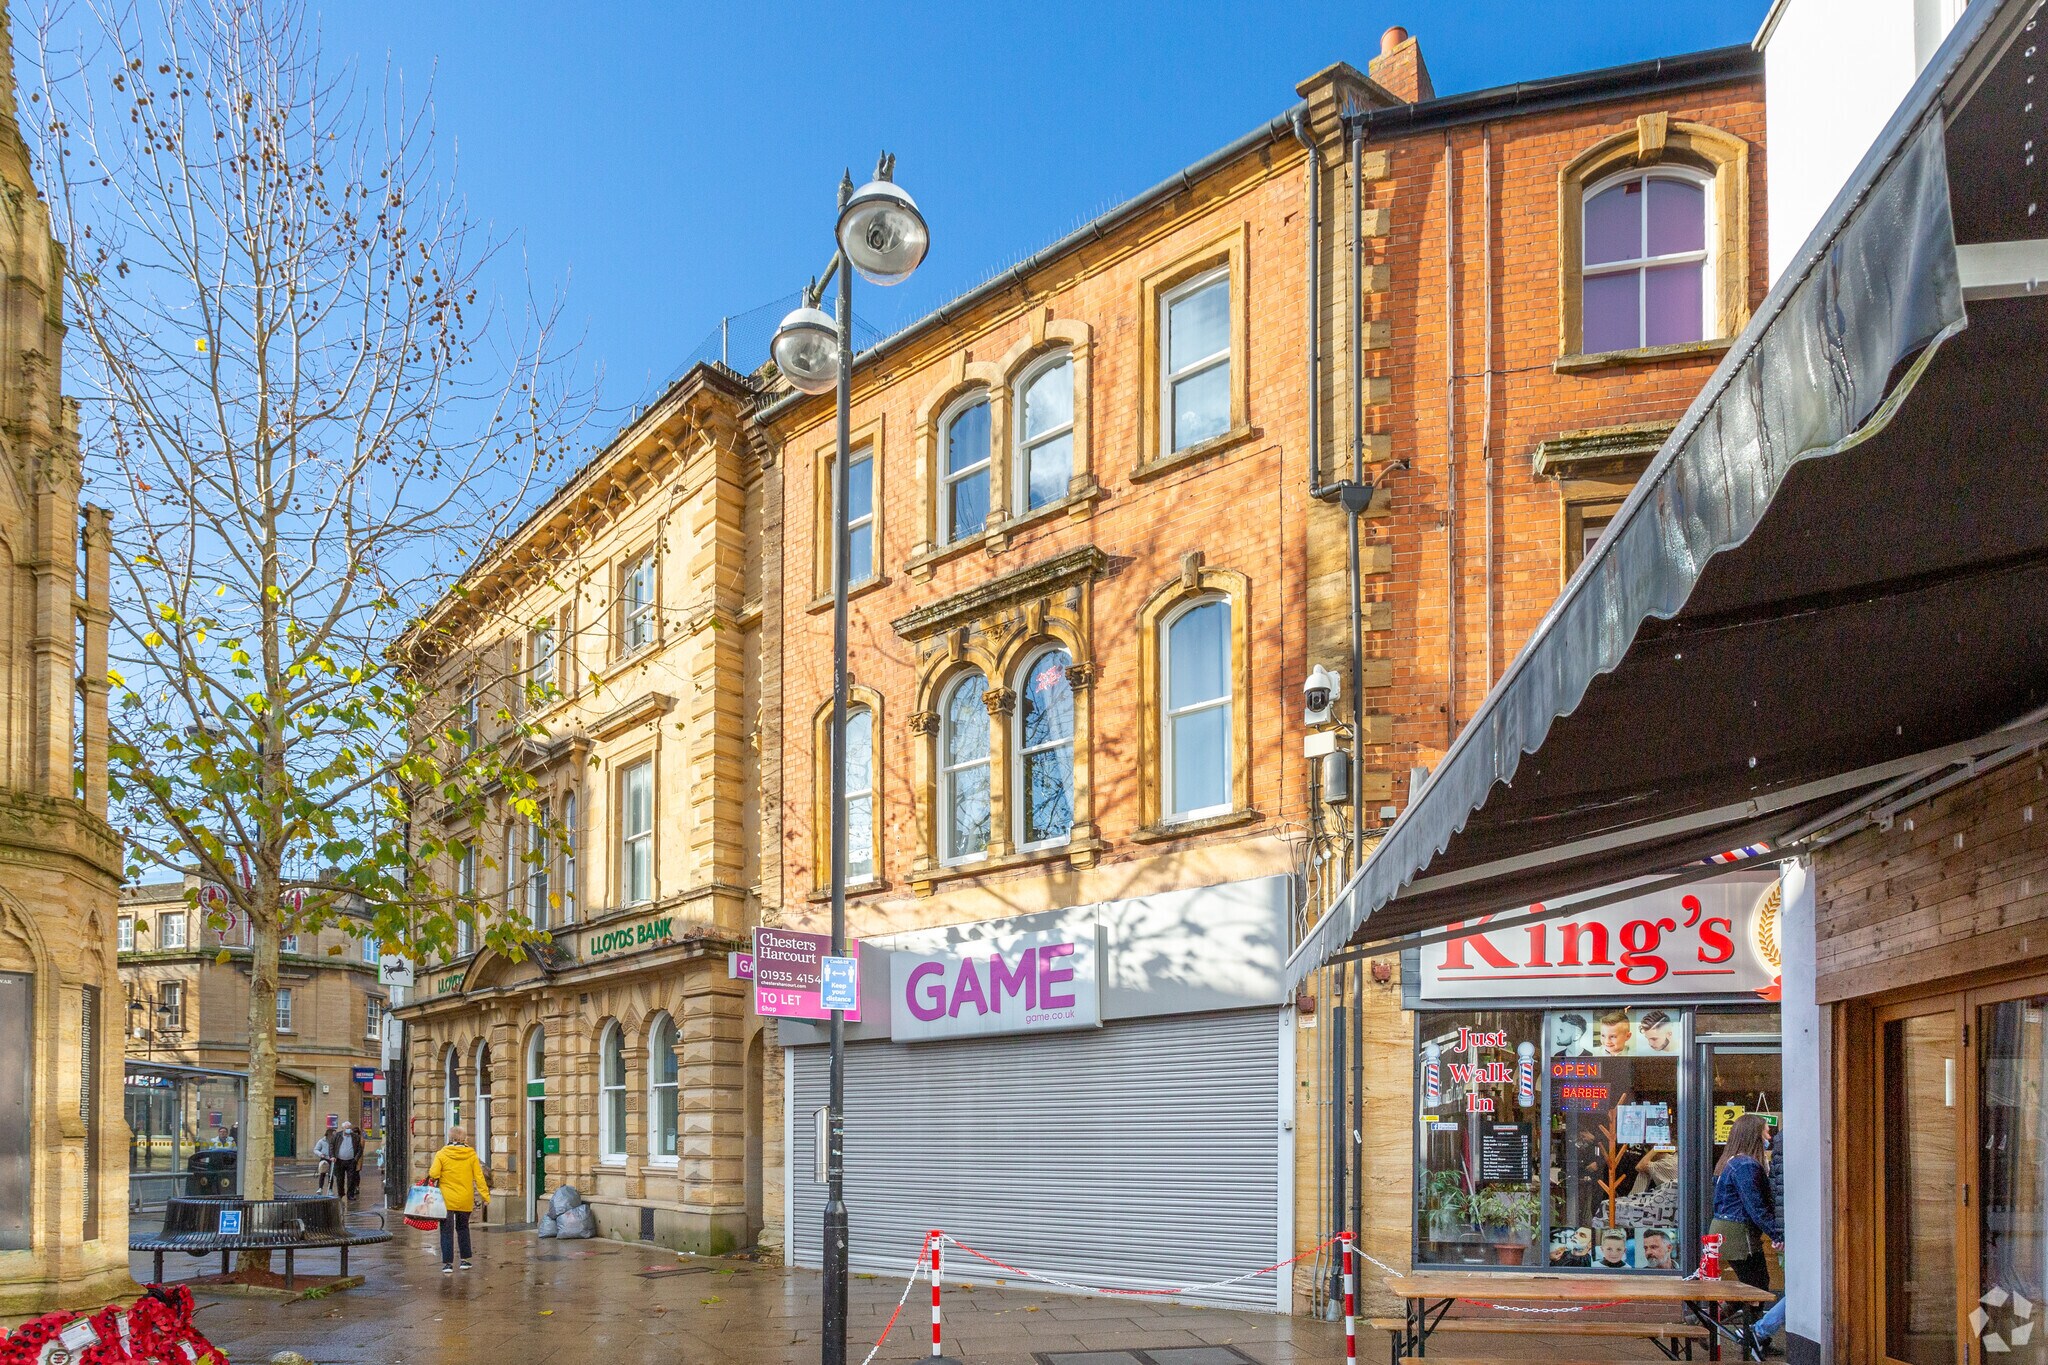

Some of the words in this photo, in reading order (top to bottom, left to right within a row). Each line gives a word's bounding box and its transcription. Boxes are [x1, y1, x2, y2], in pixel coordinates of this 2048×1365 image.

[591, 927, 635, 956] LLOYDS
[637, 916, 673, 944] BANK
[760, 933, 817, 952] Chesters
[1437, 894, 1735, 985] King's
[760, 947, 817, 964] Harcourt
[760, 969, 793, 982] 01935
[796, 973, 822, 985] 4154
[760, 980, 807, 989] chestersharcourt.com
[906, 942, 1076, 1022] GAME
[760, 992, 777, 1004] TO
[781, 994, 802, 1006] LET
[761, 1005, 777, 1013] Shop
[1025, 1009, 1075, 1025] game.co.uk
[1454, 1027, 1507, 1053] Just
[1447, 1063, 1513, 1083] Walk
[1553, 1064, 1598, 1076] OPEN
[1562, 1087, 1608, 1099] BARBER
[1466, 1092, 1495, 1113] In
